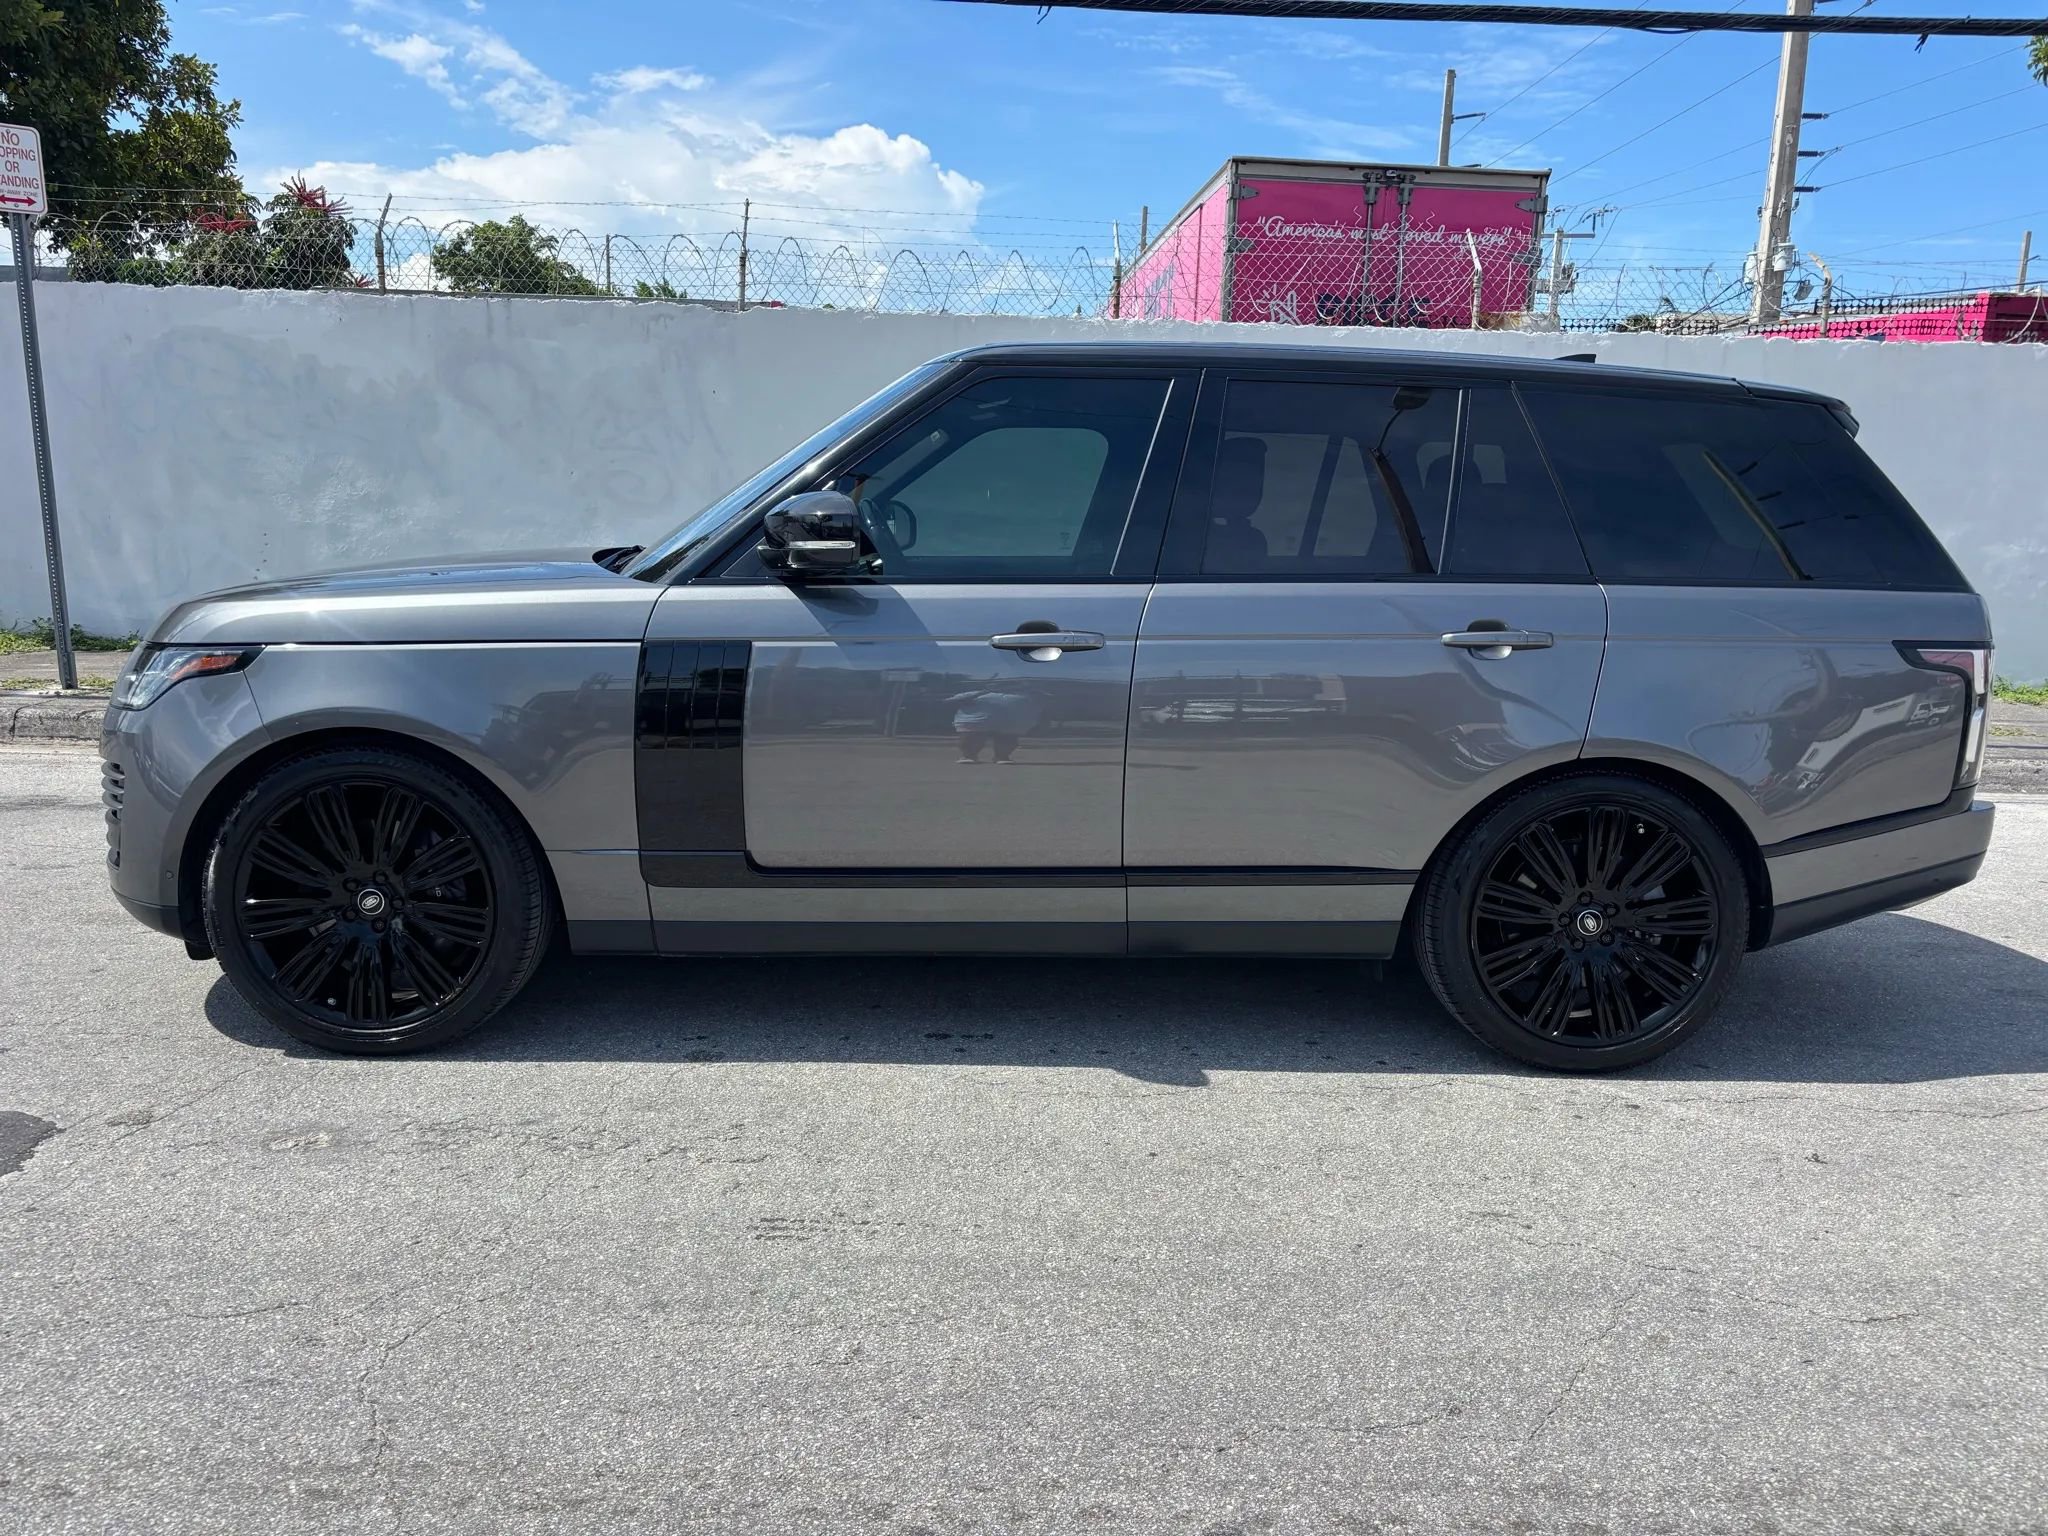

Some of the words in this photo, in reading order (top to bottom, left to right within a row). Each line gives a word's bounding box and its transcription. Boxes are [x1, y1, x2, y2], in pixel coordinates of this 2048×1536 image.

[1, 132, 20, 146] NO
[5, 160, 20, 173] OR
[0, 174, 39, 189] ANDING
[1350, 222, 1391, 240] mst
